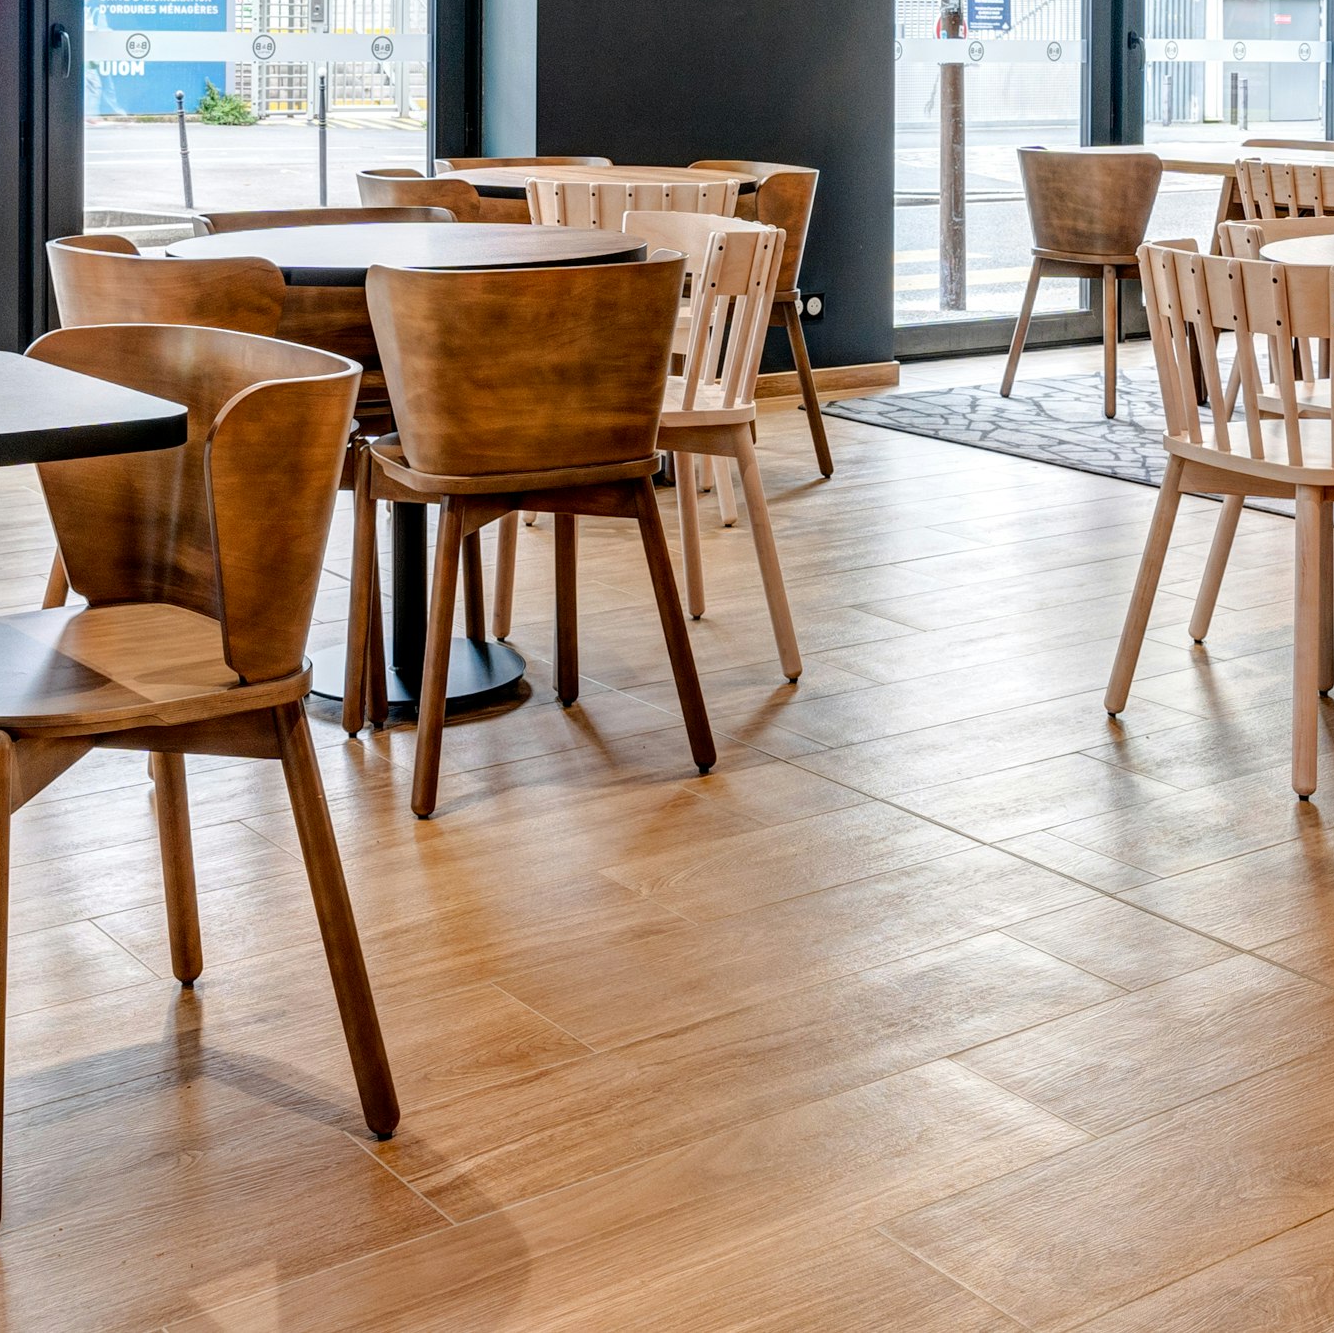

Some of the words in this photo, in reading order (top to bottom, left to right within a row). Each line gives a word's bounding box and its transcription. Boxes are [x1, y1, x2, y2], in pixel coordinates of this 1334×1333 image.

[99, 5, 156, 14] D'ORDURES
[159, 3, 218, 14] MÉNAGÈRES
[99, 61, 145, 76] UIOM
